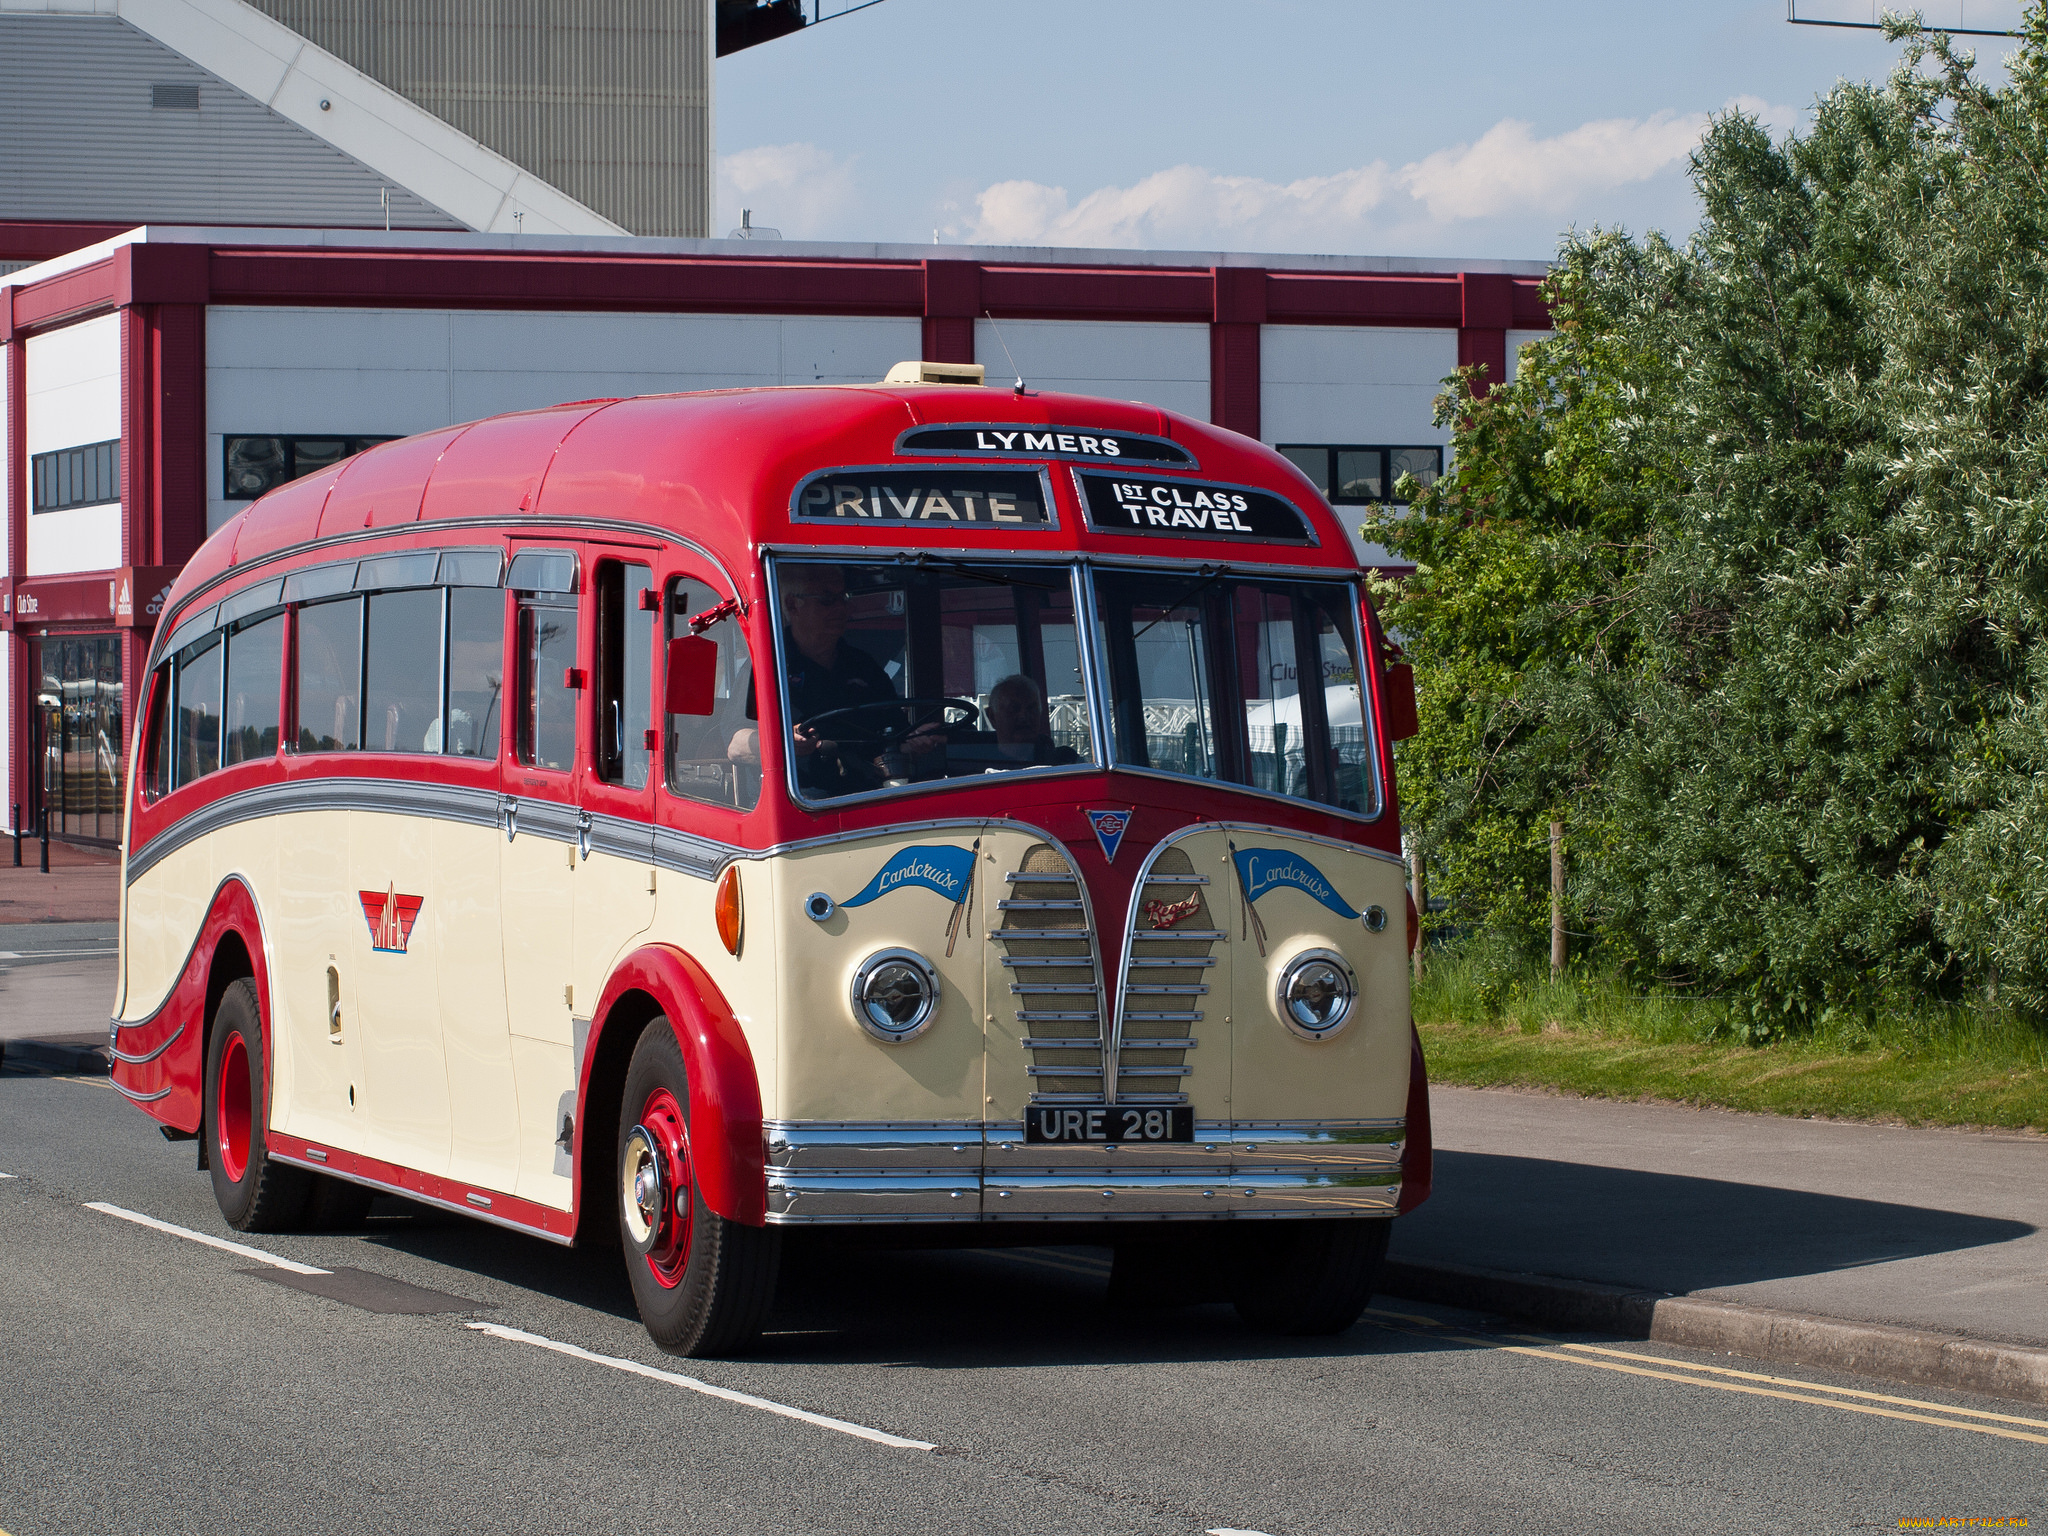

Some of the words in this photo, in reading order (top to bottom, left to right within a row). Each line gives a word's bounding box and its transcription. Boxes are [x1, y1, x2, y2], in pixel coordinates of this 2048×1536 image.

[976, 431, 1121, 457] LYMERS
[801, 482, 1023, 523] PRIVATE
[1151, 486, 1249, 512] CLASS
[1122, 503, 1254, 532] TRAVEL
[1271, 663, 1298, 681] Clu
[1098, 820, 1121, 829] AEC
[877, 857, 959, 894] Landcruise
[1248, 856, 1330, 900] Landcruise
[1144, 890, 1200, 929] Regal
[1040, 1109, 1107, 1140] URE
[1122, 1109, 1173, 1140] 281
